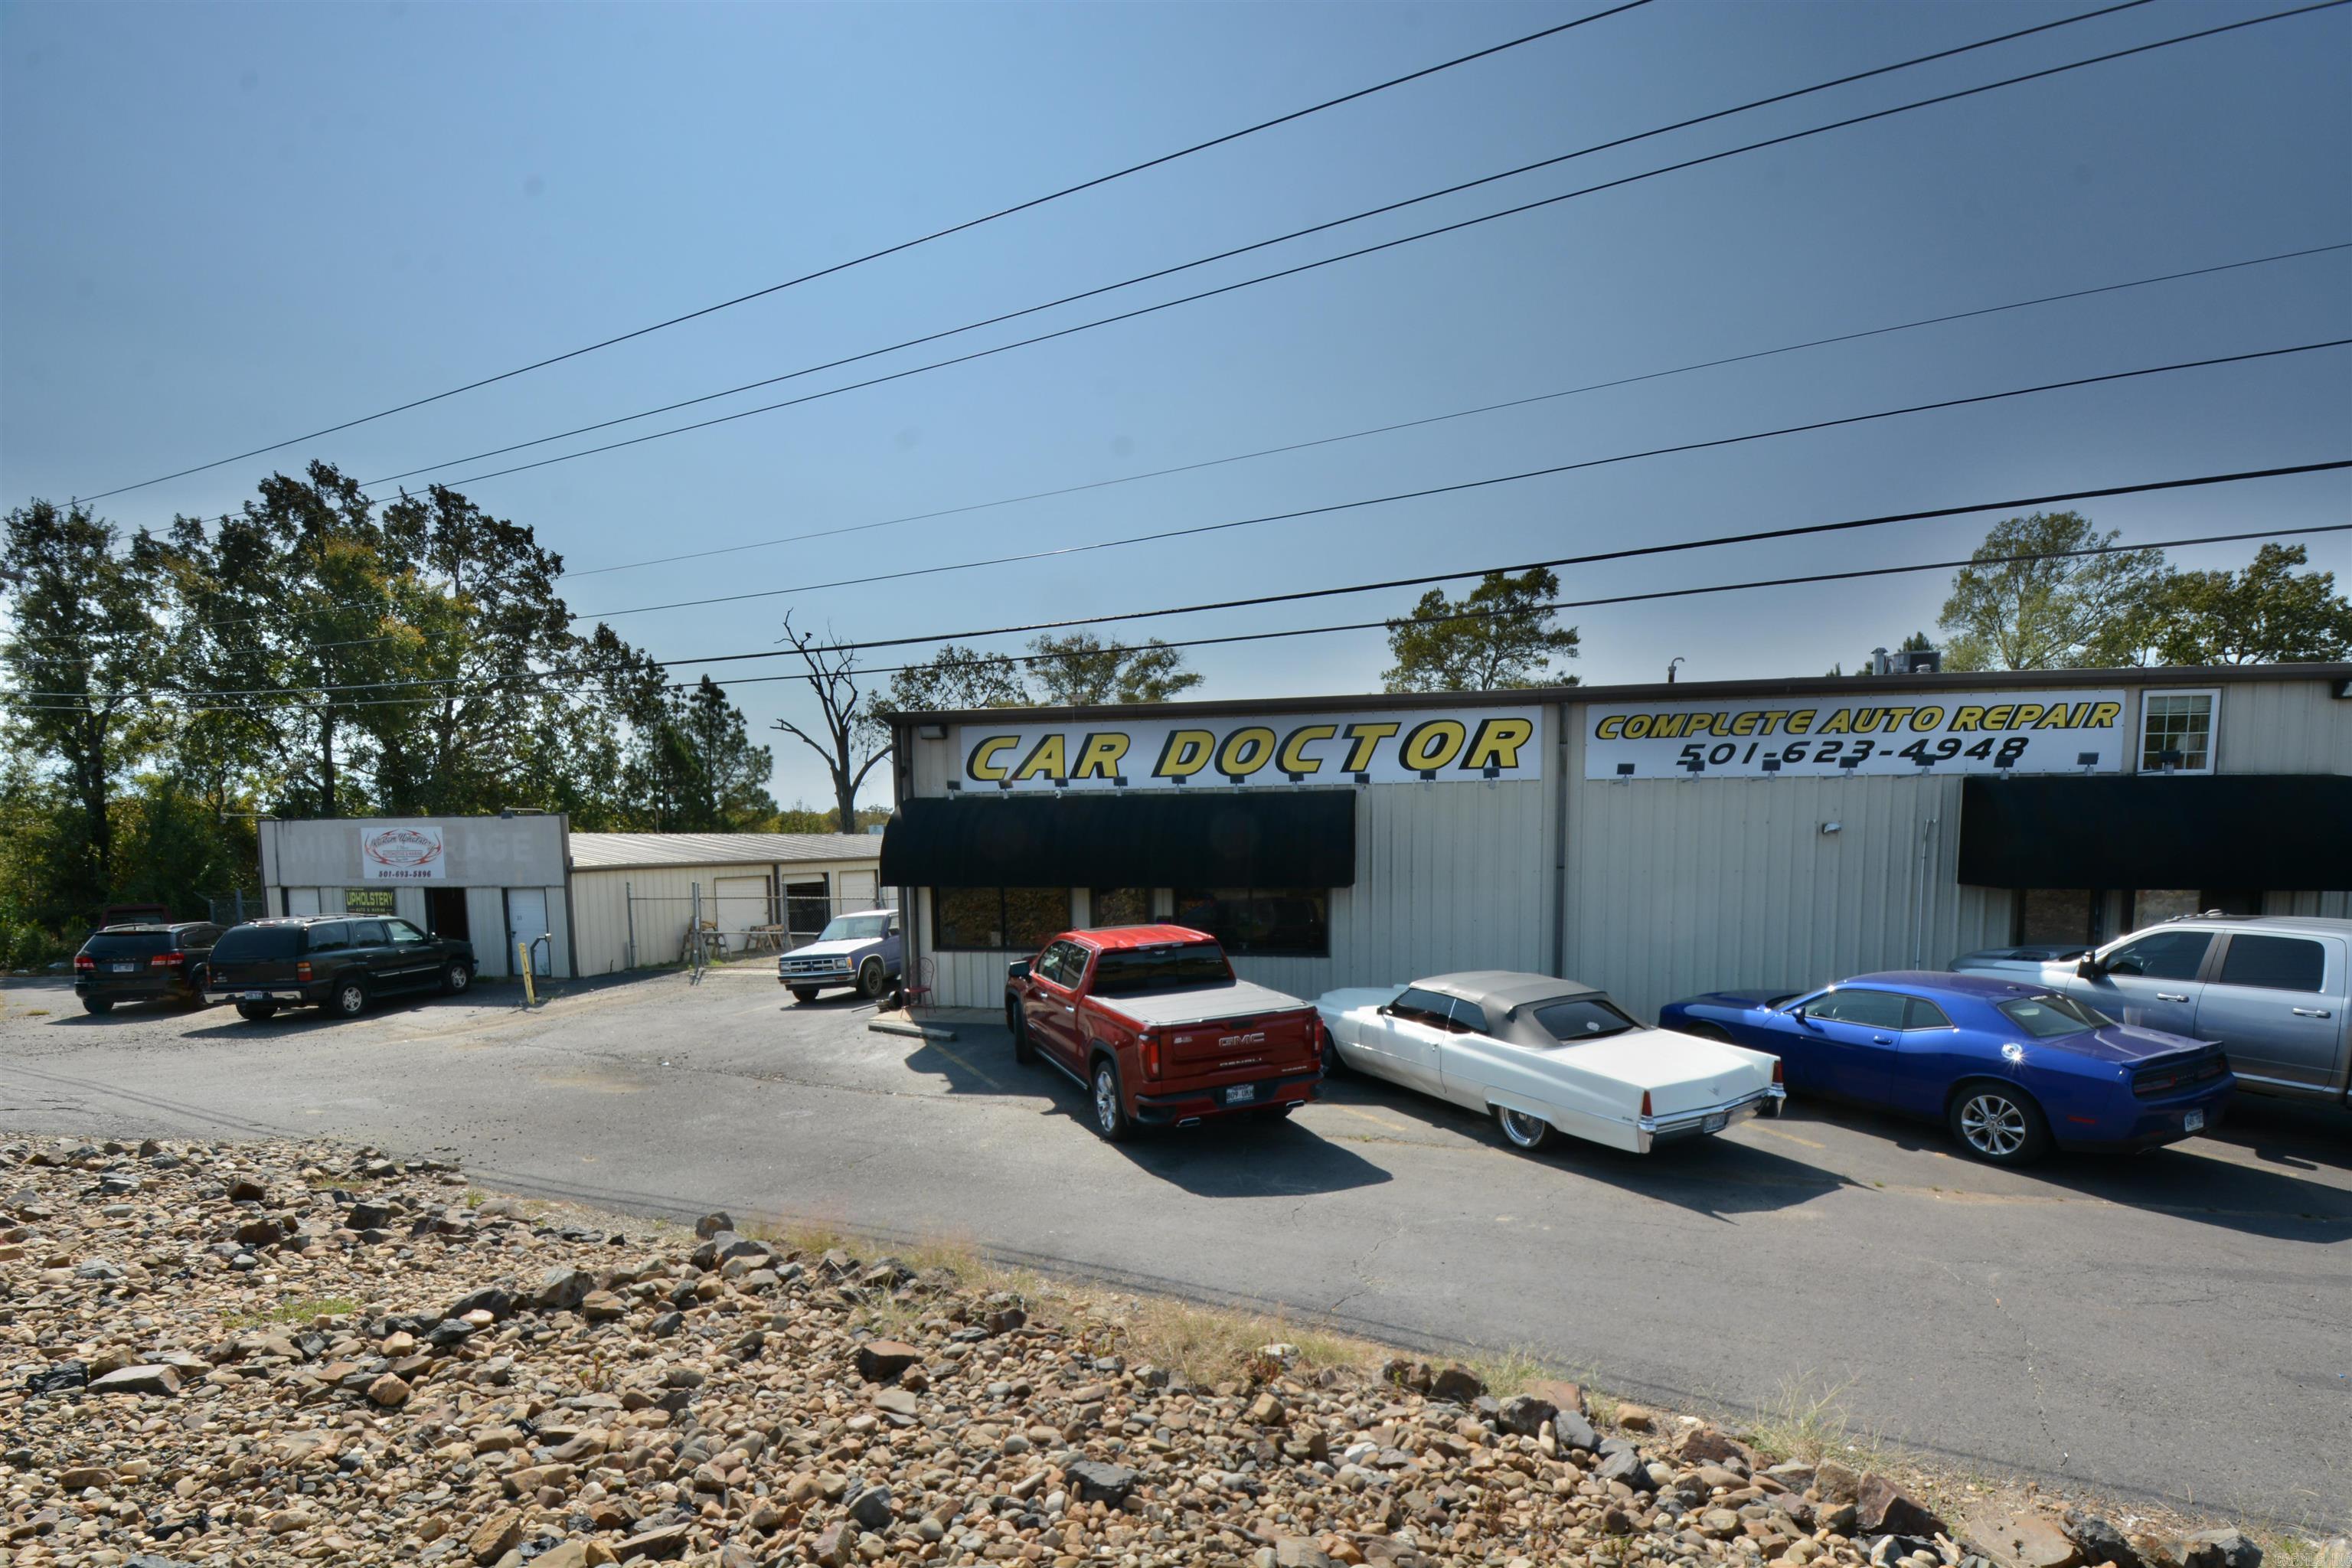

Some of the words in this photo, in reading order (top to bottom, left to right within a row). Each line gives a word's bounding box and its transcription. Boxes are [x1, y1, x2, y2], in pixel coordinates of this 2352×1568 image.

[1595, 709, 1818, 740] COMPLETE
[1815, 706, 1945, 734] AUTO
[1947, 701, 2121, 732] REPAIR
[966, 733, 1130, 781] CAR
[1151, 717, 1533, 778] DOCTOR
[1676, 737, 2030, 765] 501-623-4948
[346, 892, 393, 906] UPHOLSTERY
[1219, 1032, 1265, 1047] GMC
